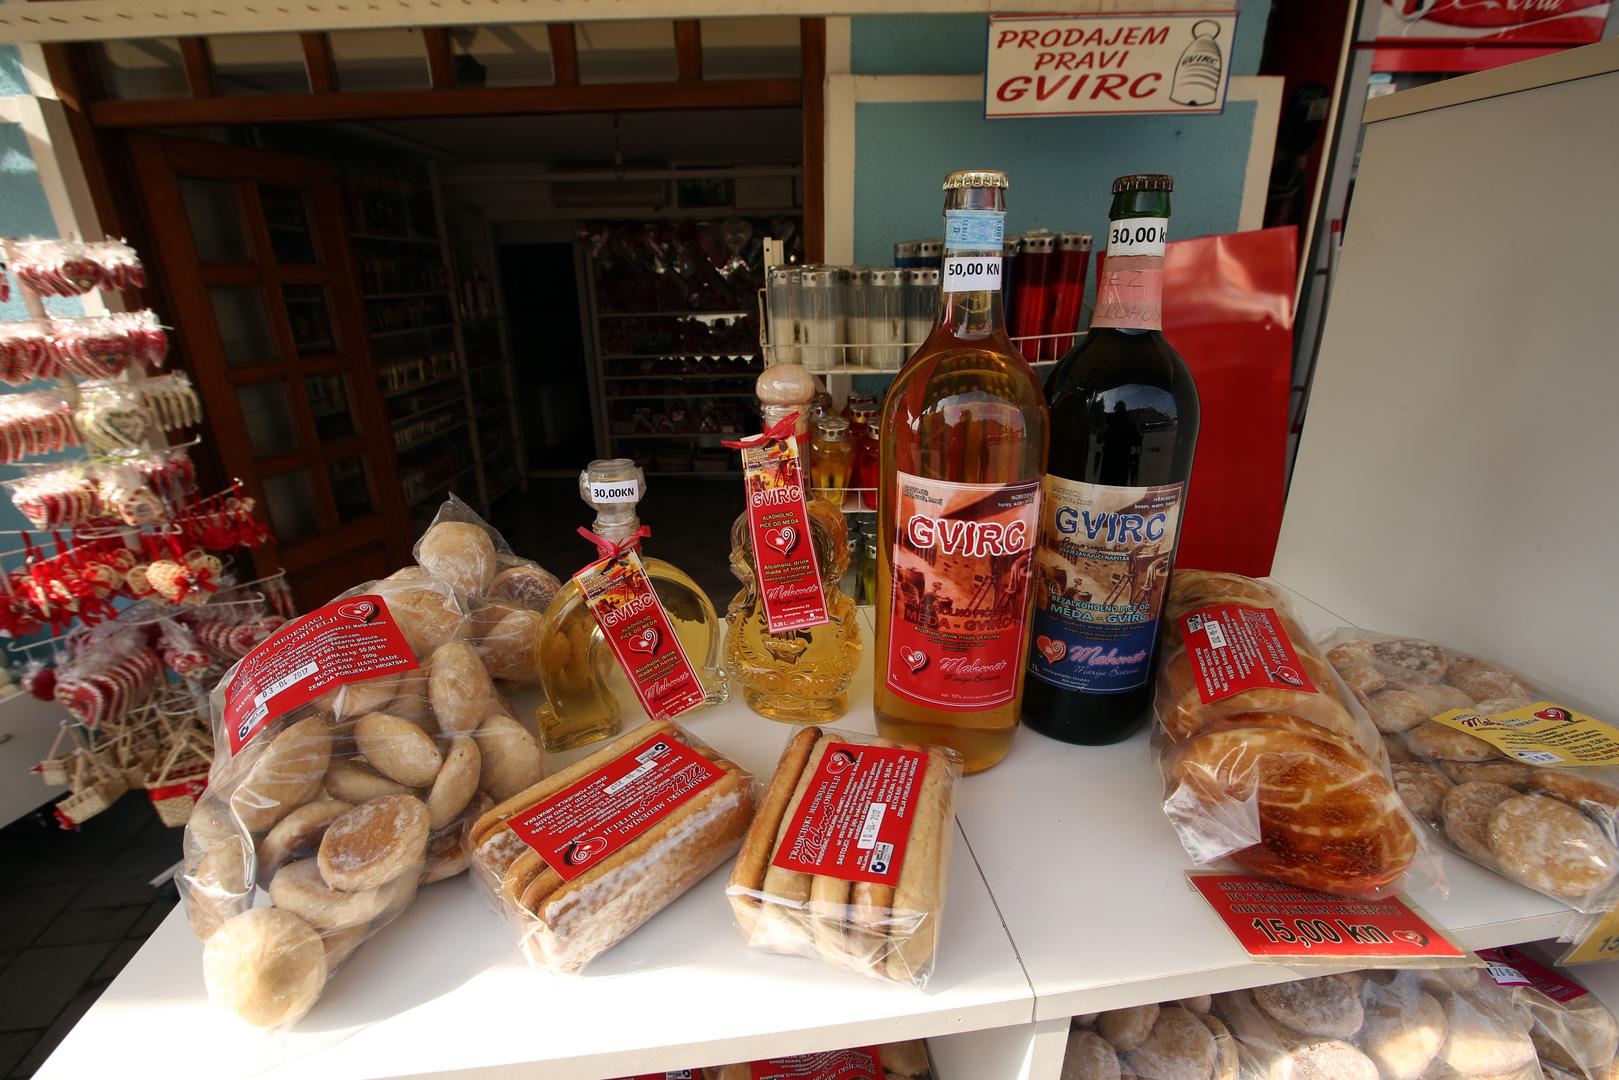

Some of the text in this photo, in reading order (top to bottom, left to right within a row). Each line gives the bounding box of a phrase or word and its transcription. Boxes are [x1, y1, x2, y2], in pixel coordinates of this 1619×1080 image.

[996, 26, 1170, 49] PRODAJEM
[1034, 51, 1130, 71] PRAVI
[1181, 55, 1218, 66] GVIRC
[996, 72, 1163, 102] GVIRC
[1111, 227, 1156, 246] 30,00
[949, 263, 1000, 277] 50,00 KN
[593, 486, 634, 498] 30,00KN
[751, 484, 802, 509] GVIRC
[762, 510, 793, 521] ALKOHOLNO
[782, 516, 799, 525] MEDA
[1055, 505, 1167, 544] GVIRC
[908, 514, 1026, 557] GVIRC
[763, 557, 809, 571] Alcoholic drink
[764, 567, 781, 576] made
[790, 562, 809, 572] honey
[599, 590, 657, 628] GVIRC
[1050, 603, 1148, 623] MEDA GVIRC
[1051, 595, 1118, 613] BEZALKOHOLNO
[291, 615, 338, 644] OBITELJI
[619, 615, 652, 633] ALKOHOLNO
[642, 618, 658, 628] MEDA
[904, 609, 1015, 631] MEDA GVIRC
[272, 615, 323, 647] MEDENJACI
[914, 626, 940, 637] Alcoholic
[318, 651, 341, 665] CIJENA
[633, 657, 662, 674] Alcoholic
[660, 649, 676, 660] drink
[636, 666, 653, 678] made
[659, 654, 678, 666] honey
[292, 667, 309, 679] 2017
[307, 674, 335, 692] ZEMLJA
[374, 657, 408, 669] HRVATSKA
[312, 666, 337, 682] RUČNI
[356, 657, 378, 666] HAND
[585, 775, 608, 789] ZEMLJA
[822, 775, 841, 804] OBITELJI
[572, 793, 587, 803] RAD
[617, 770, 712, 835] TRADICIJSKI MEDENJACI
[522, 806, 555, 826] HRVATSKA
[552, 802, 572, 816] HAND
[533, 813, 554, 827] MADE
[600, 805, 646, 836] OBITELJI
[787, 780, 828, 861] TRADICIJSKI MEDENJACI
[835, 839, 850, 865] SASTOJCI:
[1252, 917, 1394, 948] 15,00 kn
